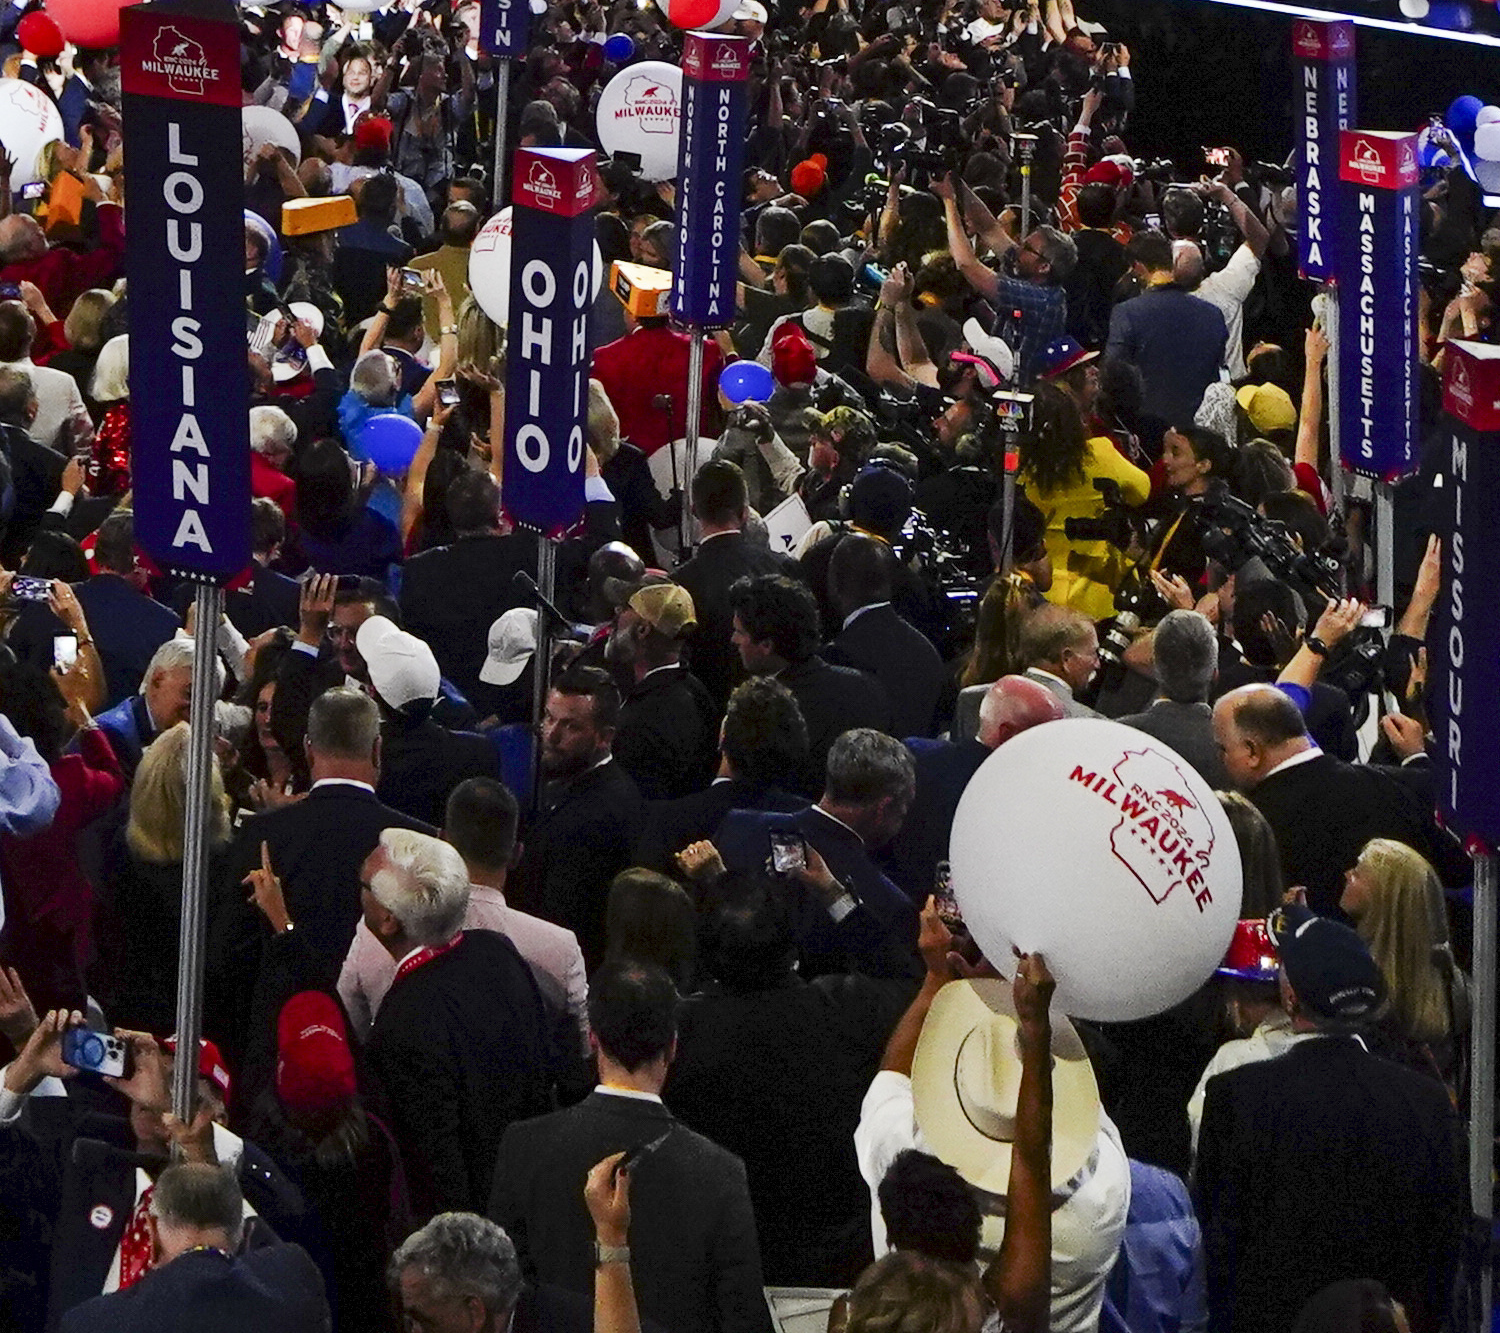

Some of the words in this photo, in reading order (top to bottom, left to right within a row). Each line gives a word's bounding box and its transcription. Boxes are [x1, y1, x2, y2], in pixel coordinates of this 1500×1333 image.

[142, 59, 220, 82] MILWAUKEE
[614, 105, 681, 120] MILWAUKE
[684, 84, 695, 168] NORTH
[716, 88, 730, 172] NORTH
[1303, 66, 1323, 266] NEBRASKA
[676, 176, 690, 312] CAROLINA
[707, 181, 725, 315] CAROLINA
[168, 122, 213, 553] LOUISIANA
[515, 259, 556, 473] OHIO
[566, 259, 589, 474] OHIO
[1359, 192, 1375, 459] MASSACHUSETTS
[1450, 434, 1468, 812] MISSOURI
[1068, 764, 1214, 913] MILWAUKEE
[1130, 783, 1159, 811] RNC
[1159, 808, 1195, 848] 2024
